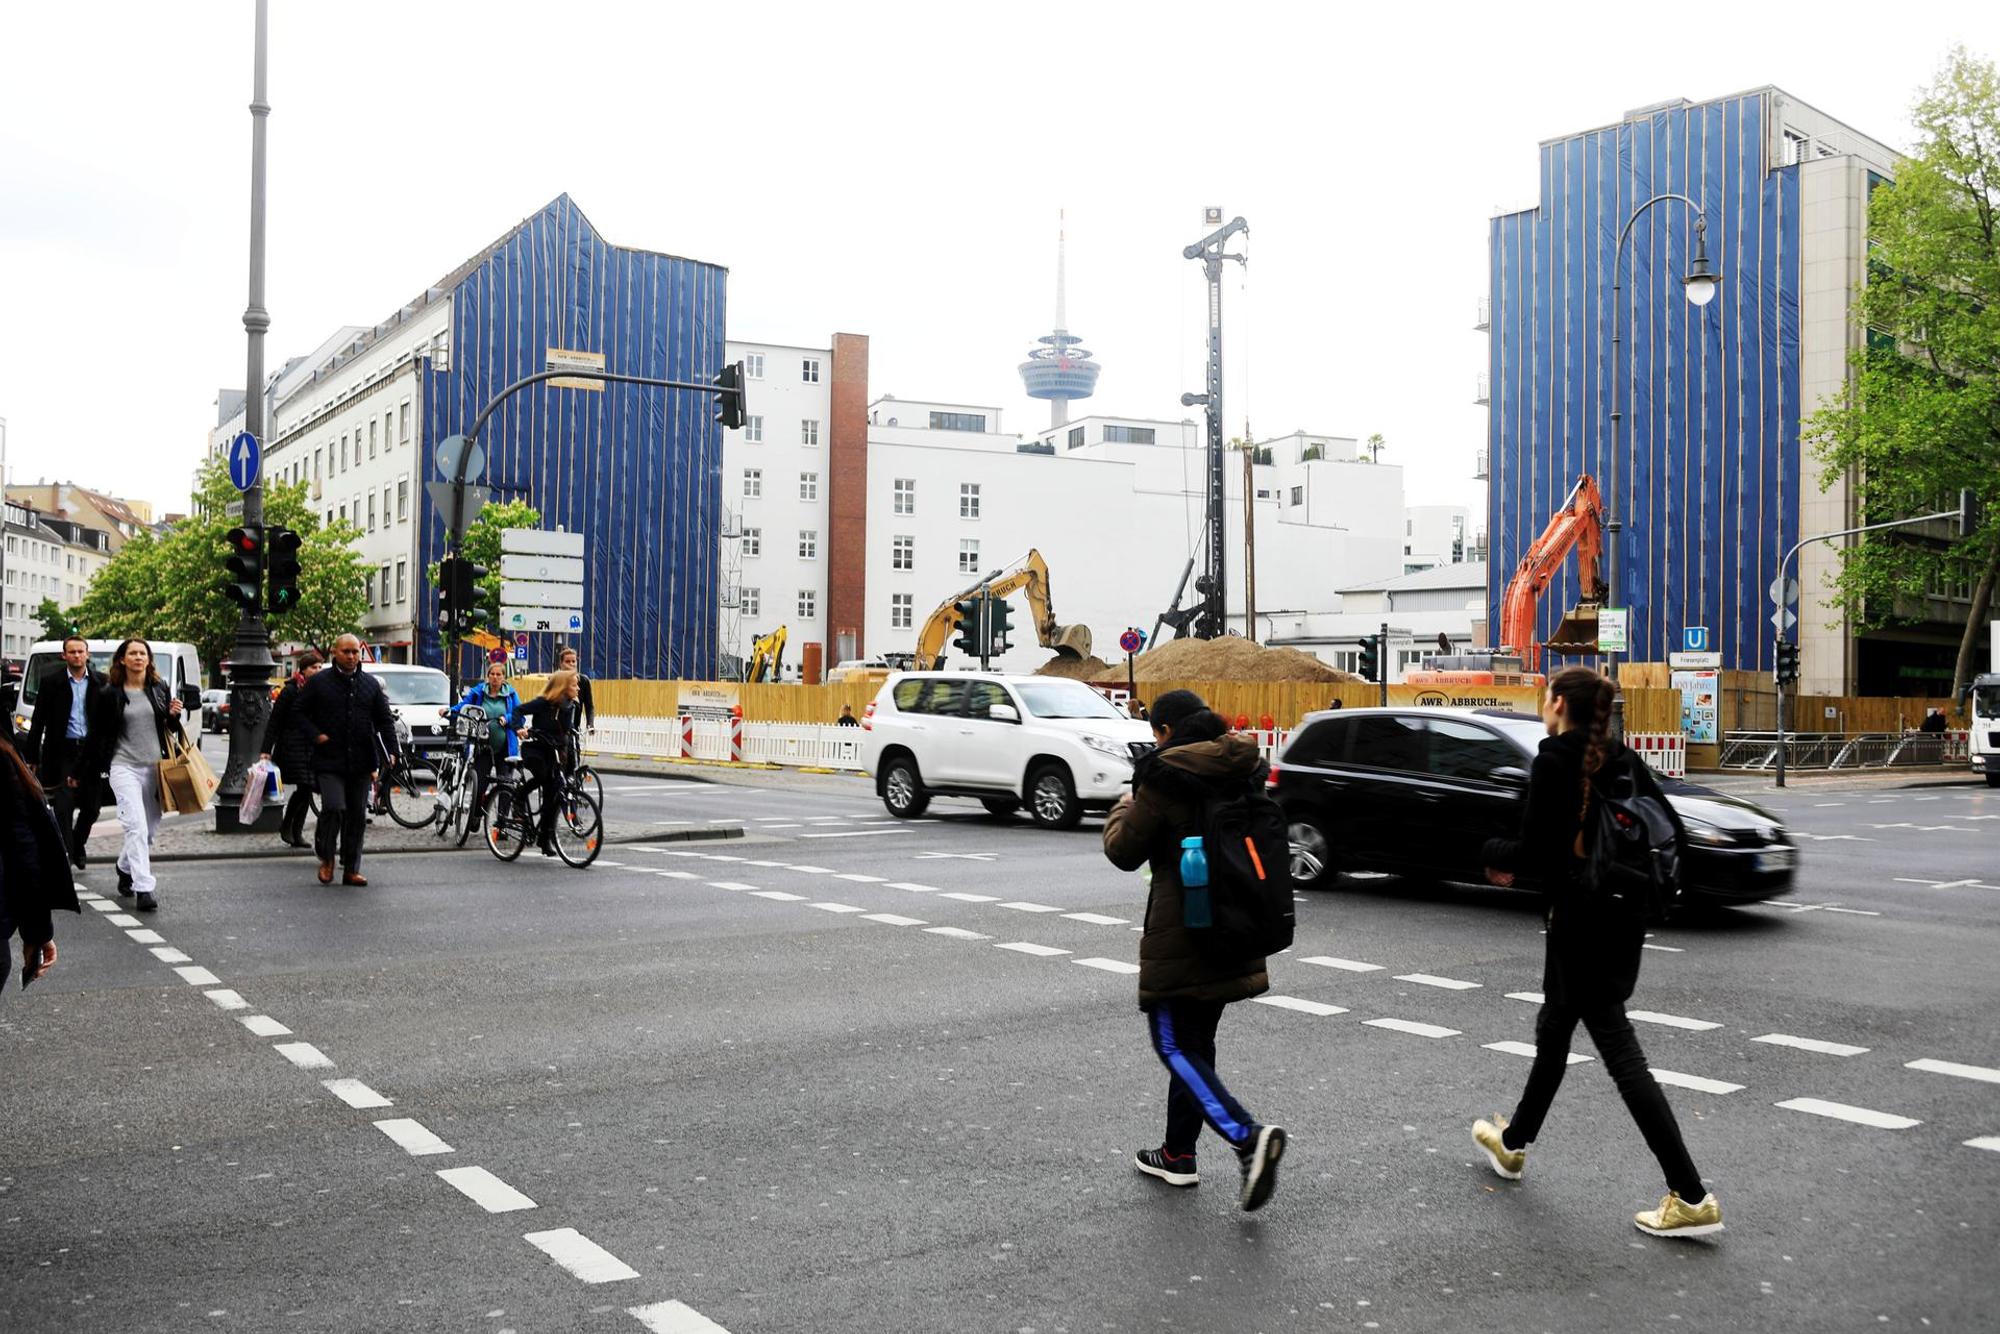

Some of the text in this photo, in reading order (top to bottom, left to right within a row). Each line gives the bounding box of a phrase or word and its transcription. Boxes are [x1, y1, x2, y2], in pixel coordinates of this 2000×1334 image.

[1688, 630, 1702, 648] U
[1420, 697, 1443, 706] AWR
[1450, 697, 1498, 706] ABBRUCH
